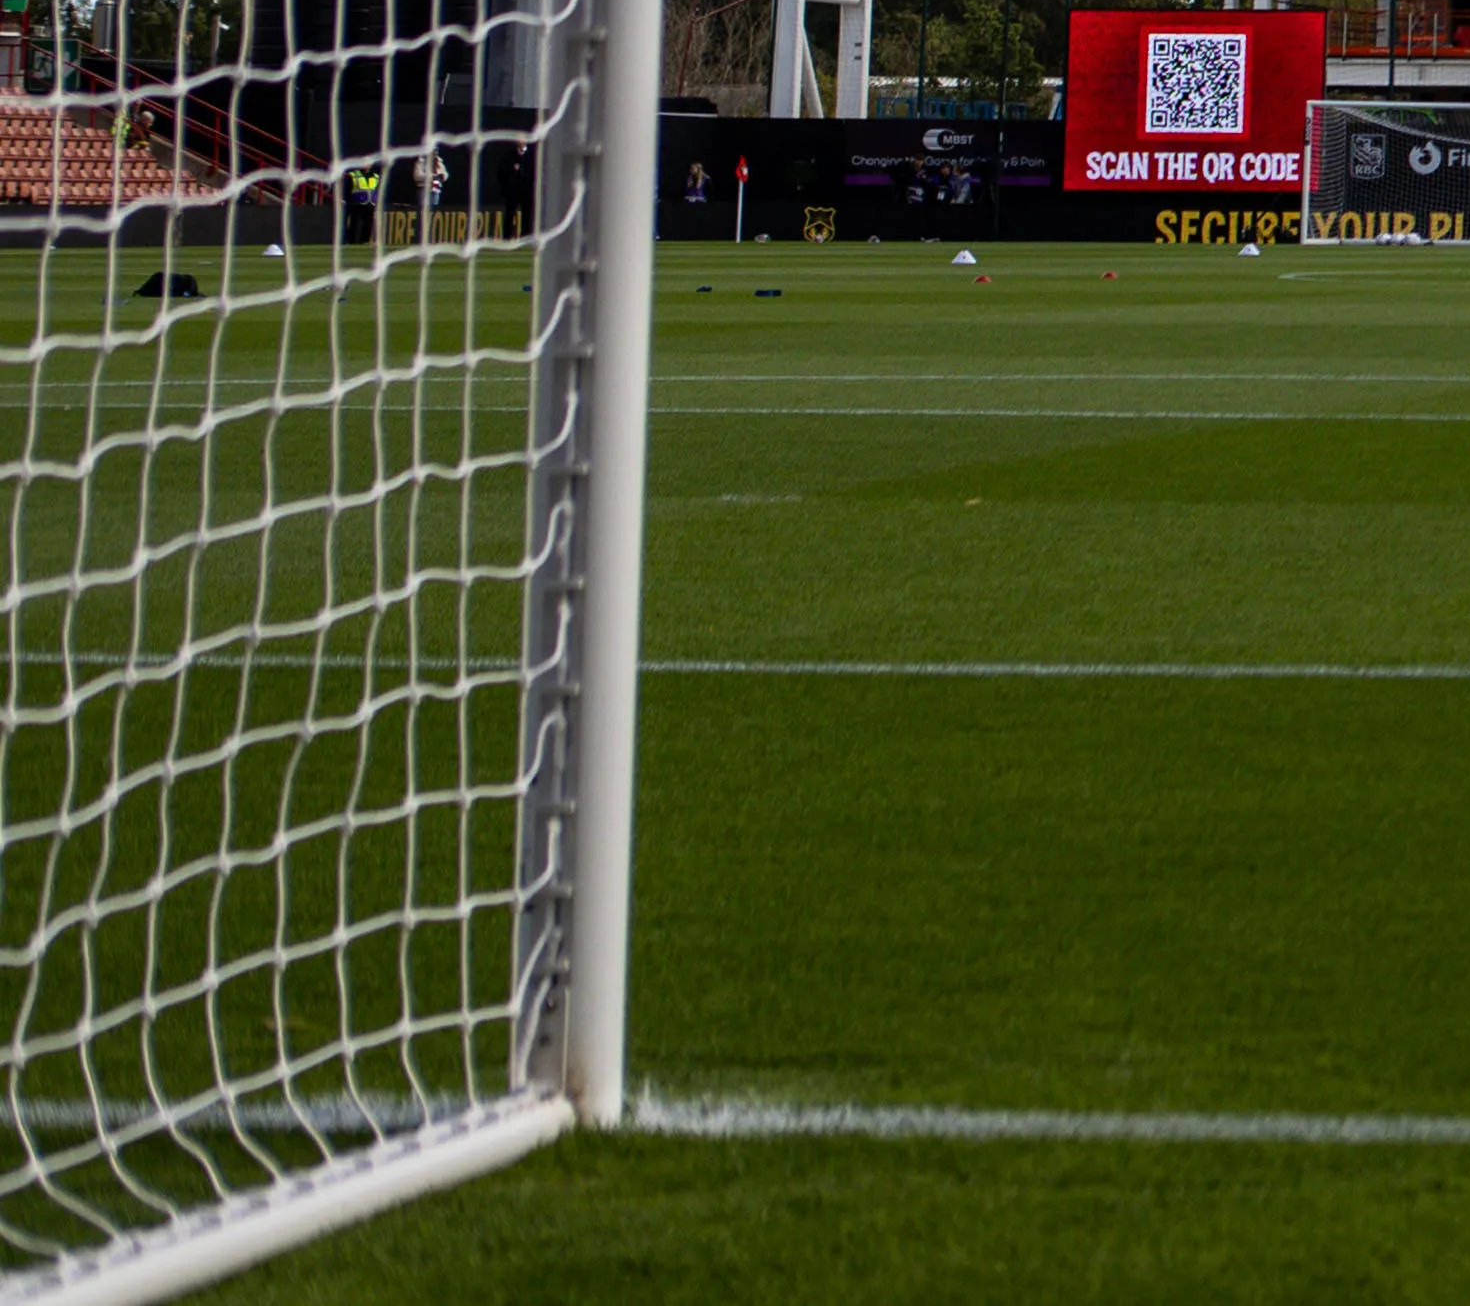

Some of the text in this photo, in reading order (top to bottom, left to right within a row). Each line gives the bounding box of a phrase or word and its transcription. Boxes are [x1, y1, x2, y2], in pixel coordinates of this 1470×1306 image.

[943, 134, 974, 145] MBST
[1086, 151, 1299, 183] SCAN THE QR CODE
